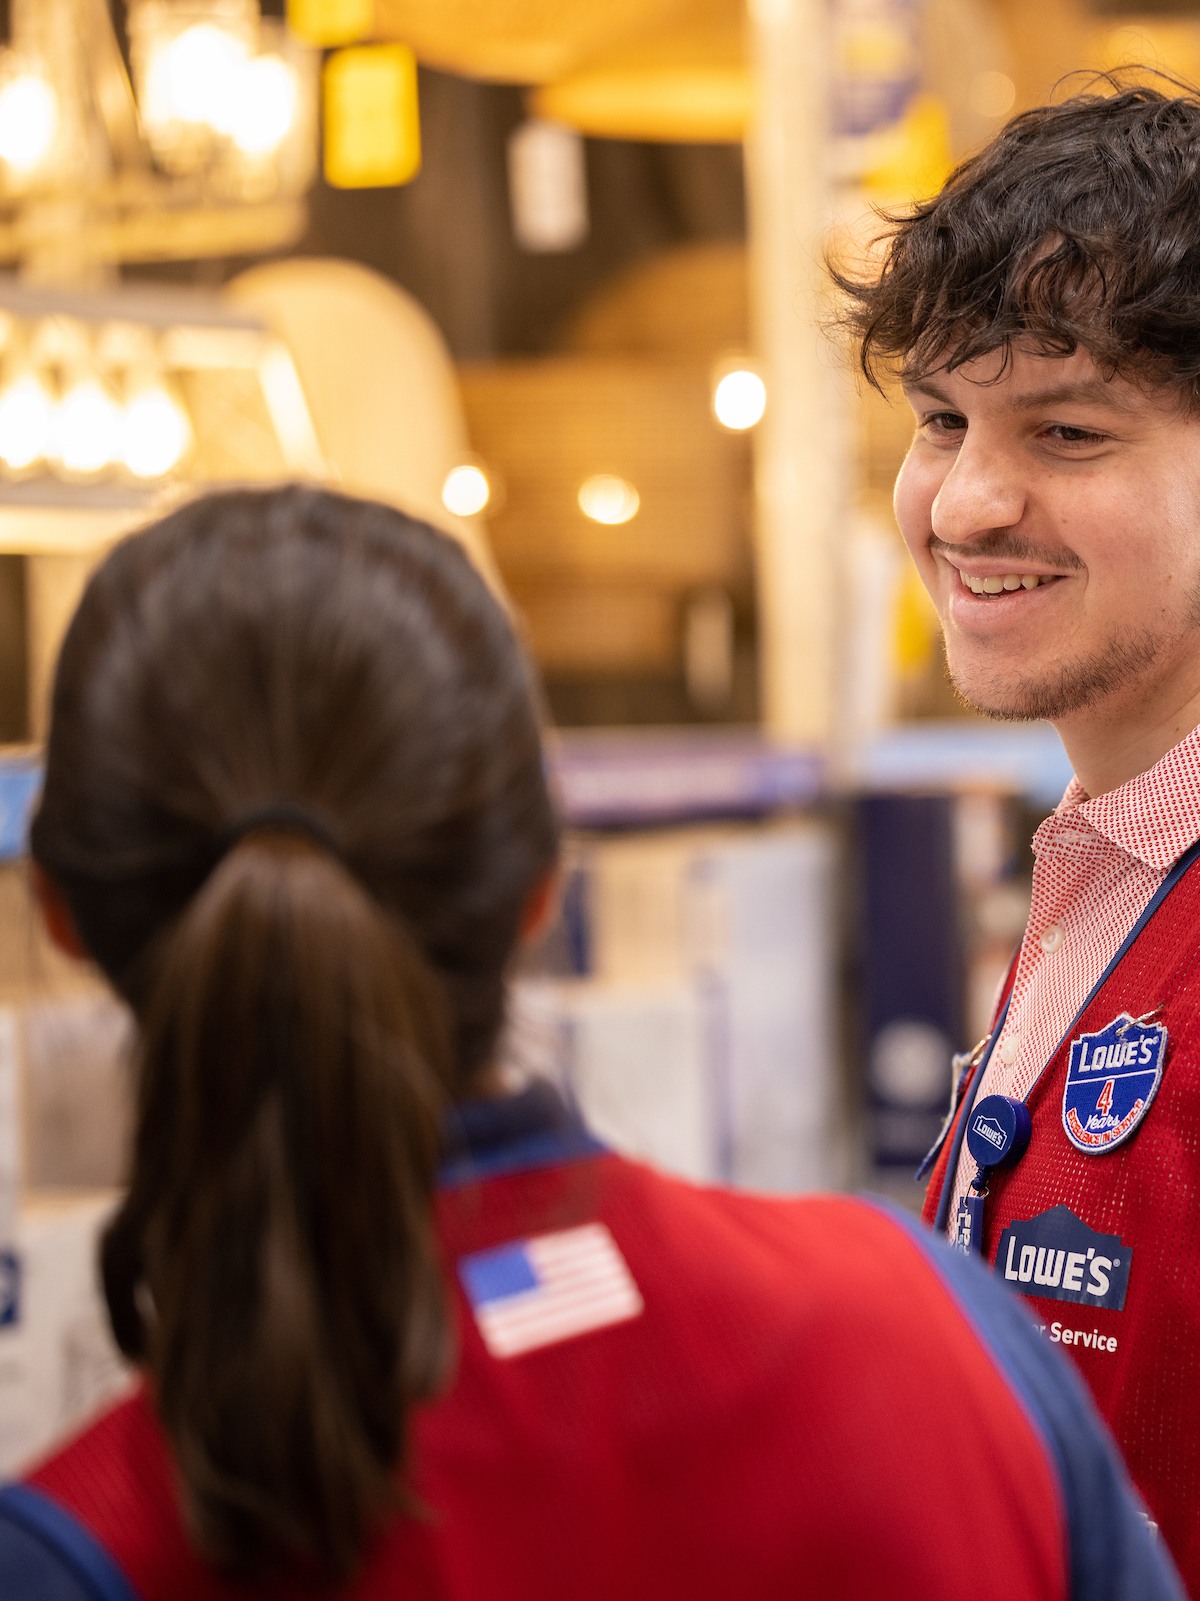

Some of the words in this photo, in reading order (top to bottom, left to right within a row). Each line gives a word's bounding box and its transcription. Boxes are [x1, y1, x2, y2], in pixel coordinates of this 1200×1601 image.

[1078, 1034, 1153, 1073] LOWE'S
[1096, 1078, 1115, 1116] 4
[976, 1119, 1003, 1146] LOWE'S
[1084, 1114, 1121, 1131] Years
[1101, 1130, 1112, 1145] IN
[1111, 1098, 1145, 1139] SERVICE
[1004, 1235, 1116, 1297] LOWE'S
[1049, 1321, 1118, 1353] Service
